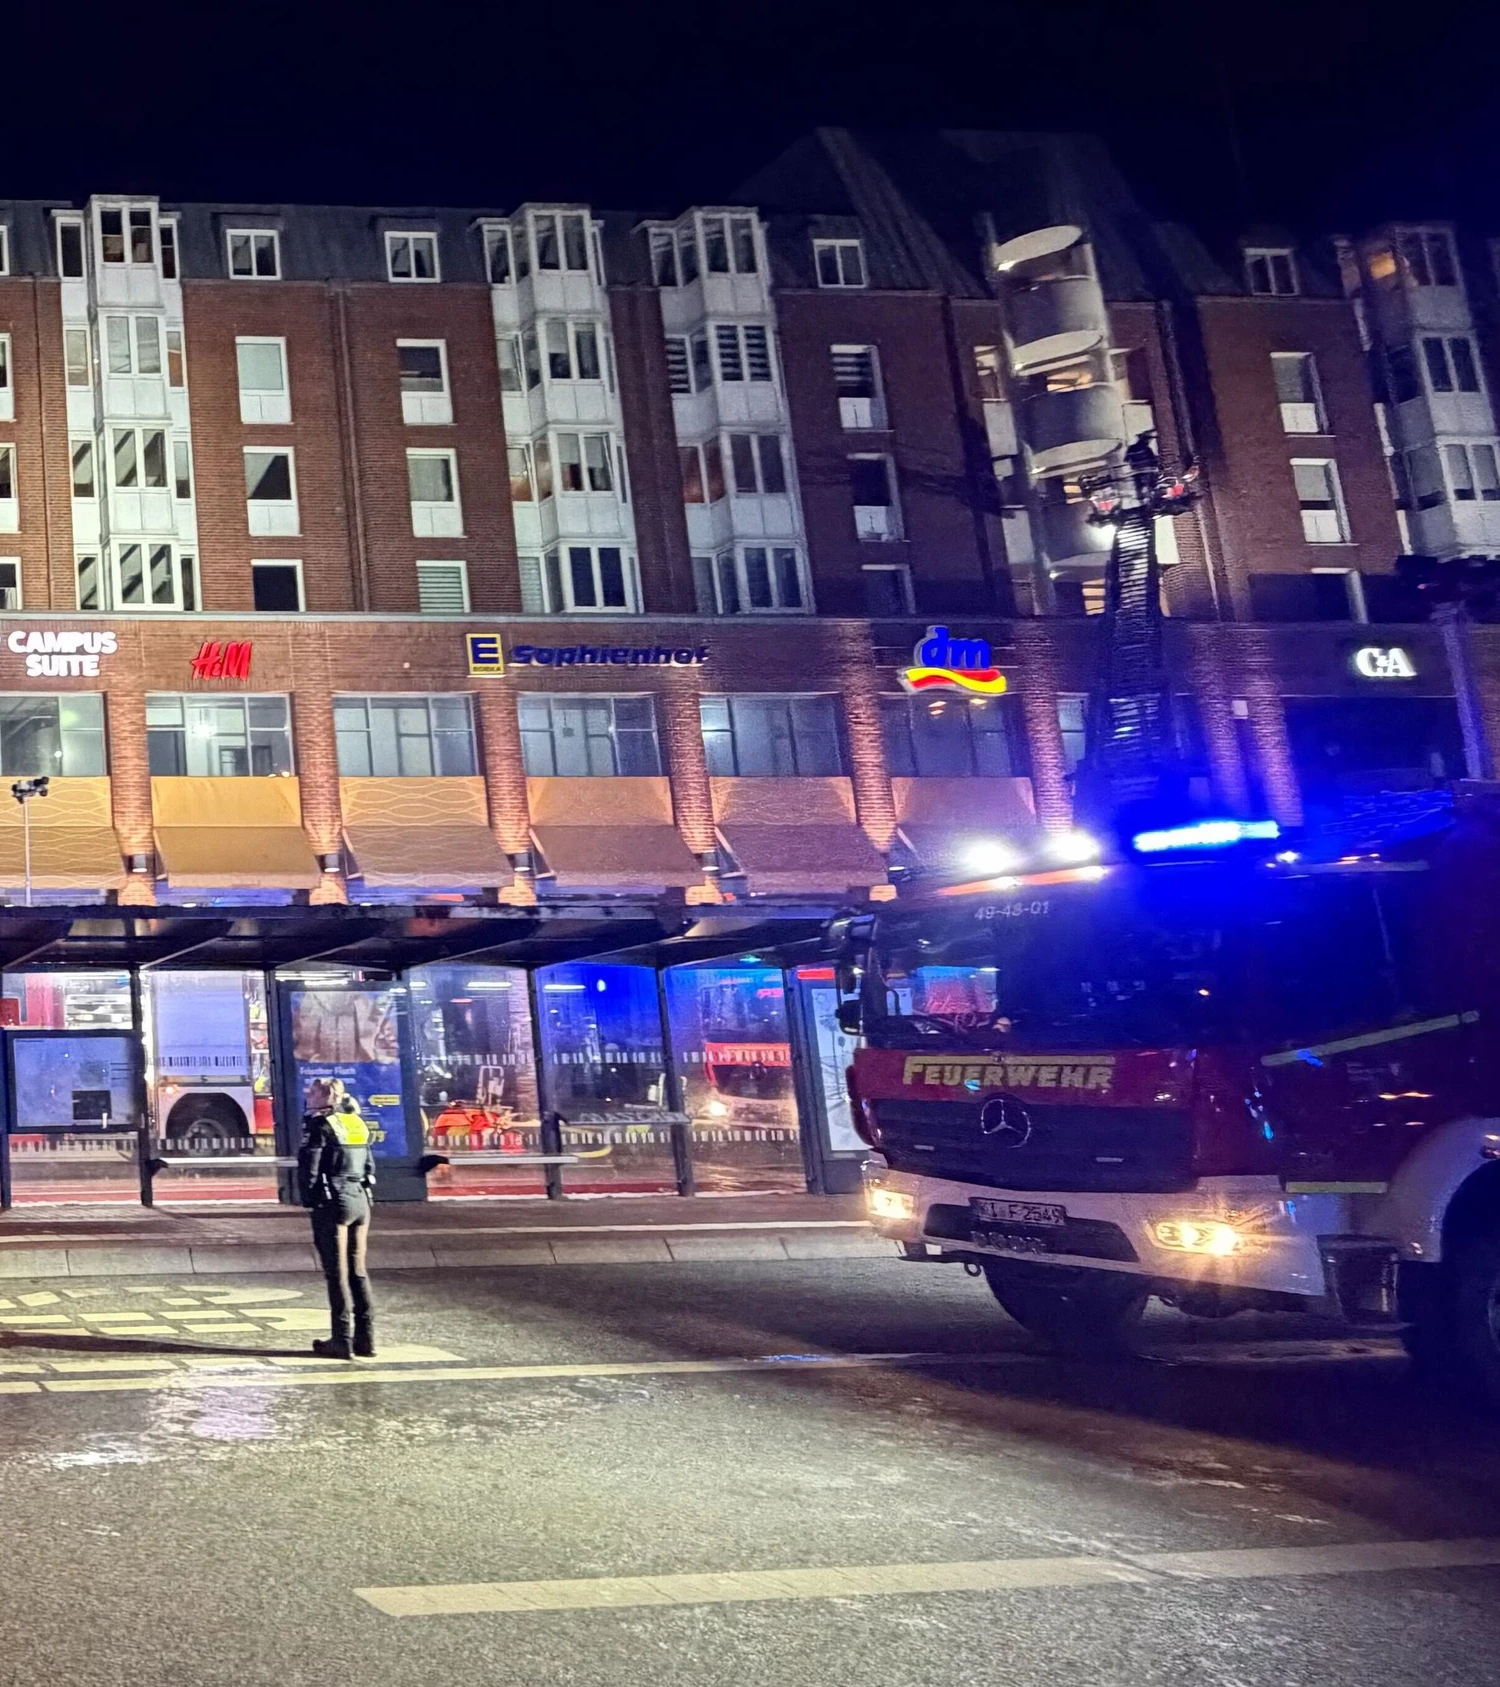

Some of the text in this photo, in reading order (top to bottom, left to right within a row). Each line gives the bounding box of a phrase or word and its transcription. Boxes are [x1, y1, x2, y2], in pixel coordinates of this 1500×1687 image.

[7, 631, 118, 654] CAMPUS
[512, 645, 710, 668] Sophienhof
[917, 625, 991, 669] dm
[26, 654, 100, 677] SUITE
[192, 641, 253, 681] H&M
[1356, 647, 1417, 677] C&A
[903, 1055, 1113, 1088] FEUERWEHR
